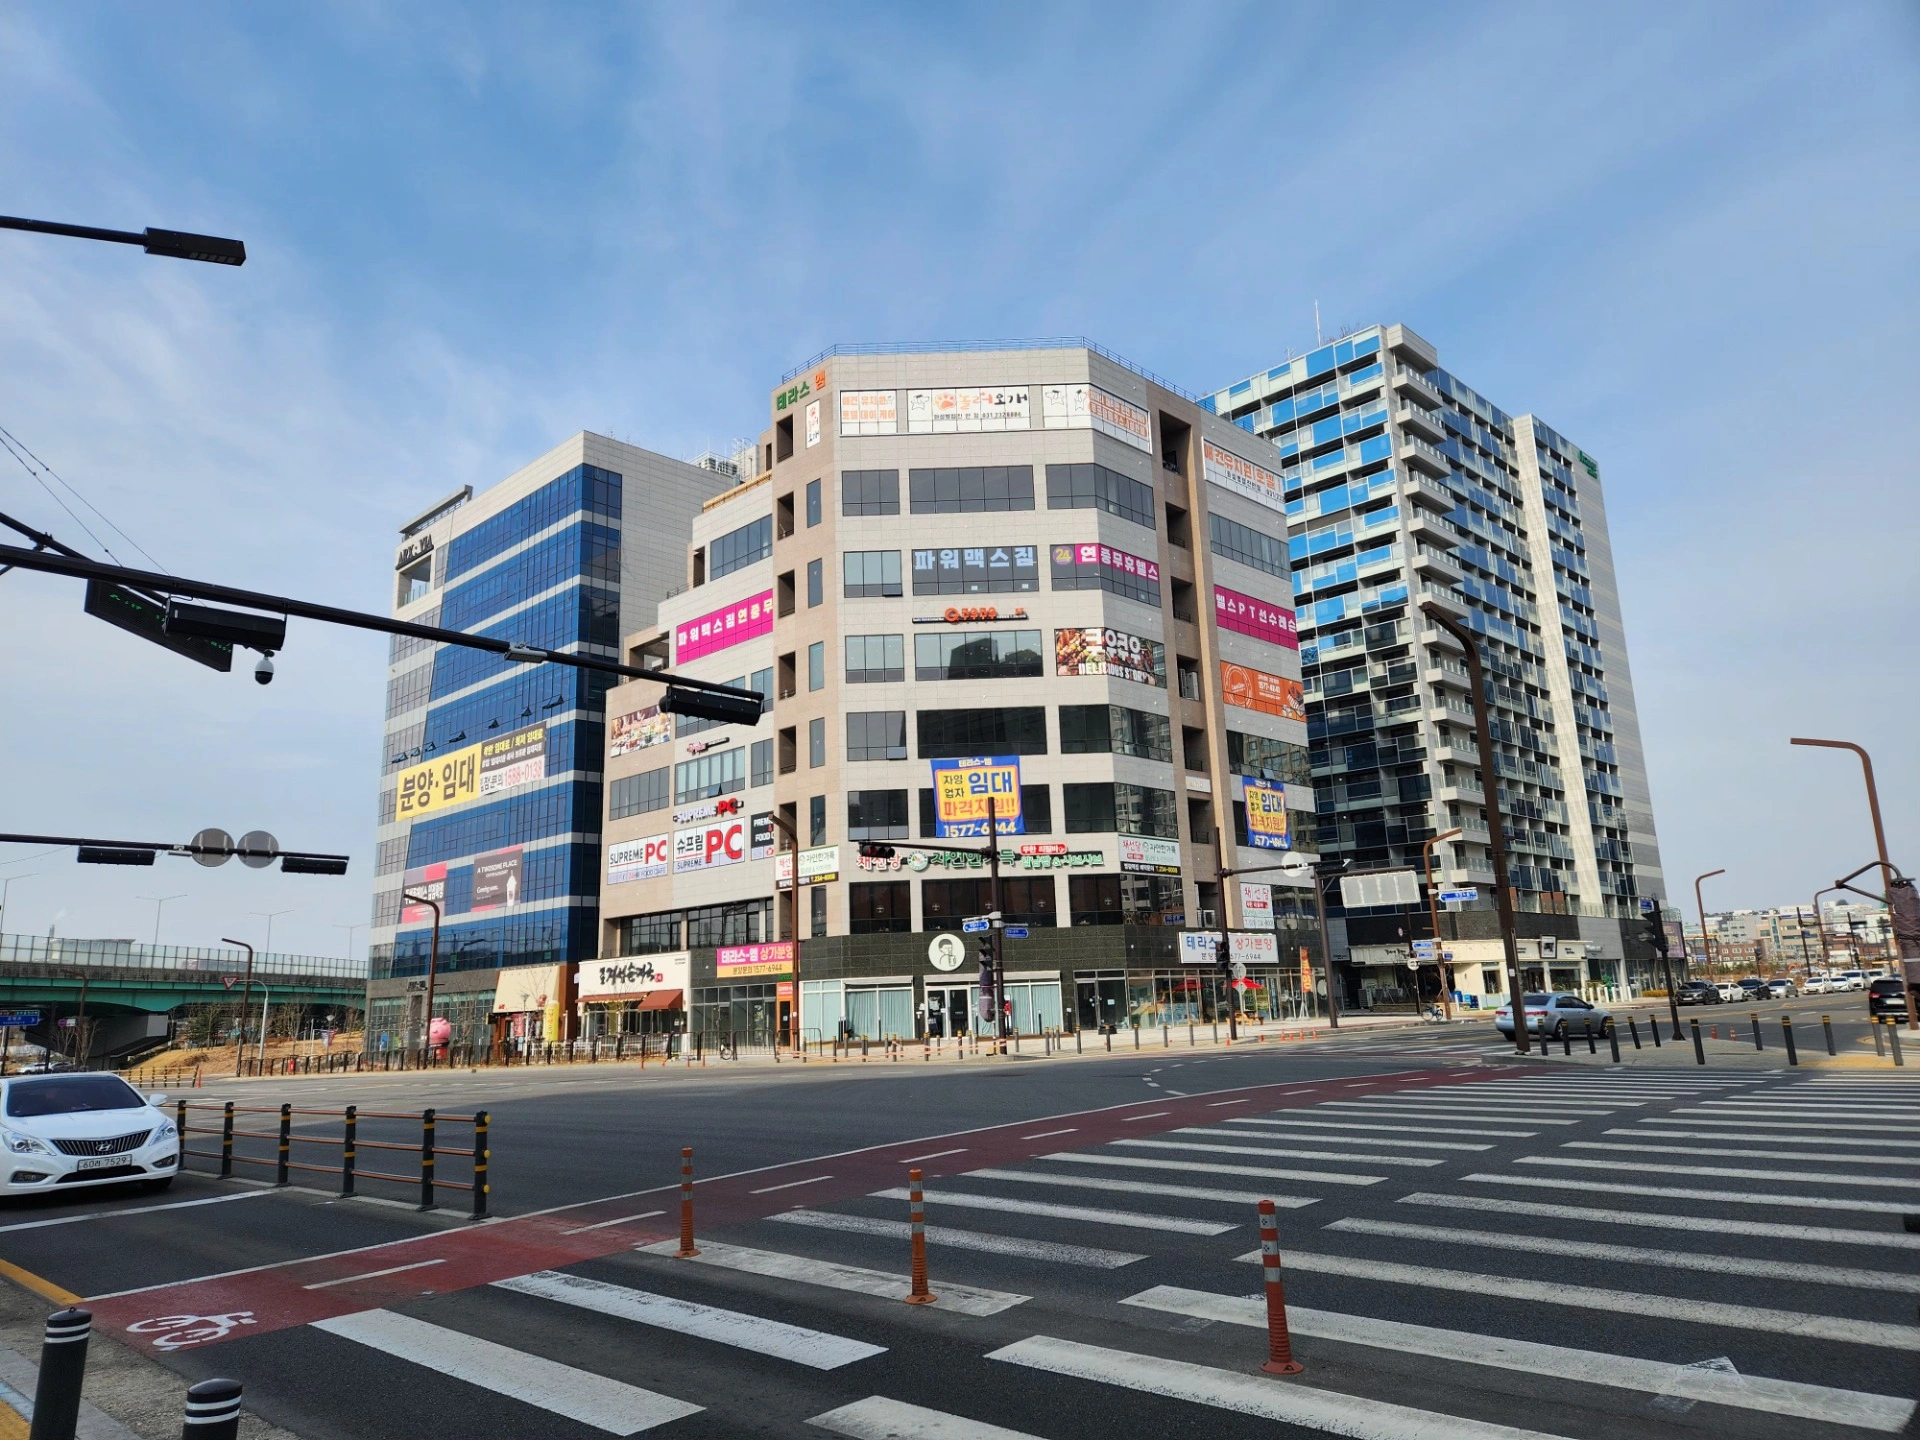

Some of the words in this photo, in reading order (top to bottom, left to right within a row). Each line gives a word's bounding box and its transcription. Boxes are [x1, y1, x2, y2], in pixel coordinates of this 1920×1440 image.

[776, 381, 810, 410] 테라스
[914, 548, 1034, 570] 파워맥스짐
[967, 771, 1012, 795] 임대
[717, 798, 737, 816] PC
[1261, 793, 1283, 813] 임대
[943, 821, 1016, 838] 1577-644
[610, 848, 643, 865] SUPREME
[645, 839, 667, 865] PC
[677, 834, 704, 855] 슈프림
[705, 824, 743, 864] PC
[677, 858, 702, 870] SUPREME
[1235, 938, 1272, 951] 상가분양
[104, 1156, 127, 1166] 7529
